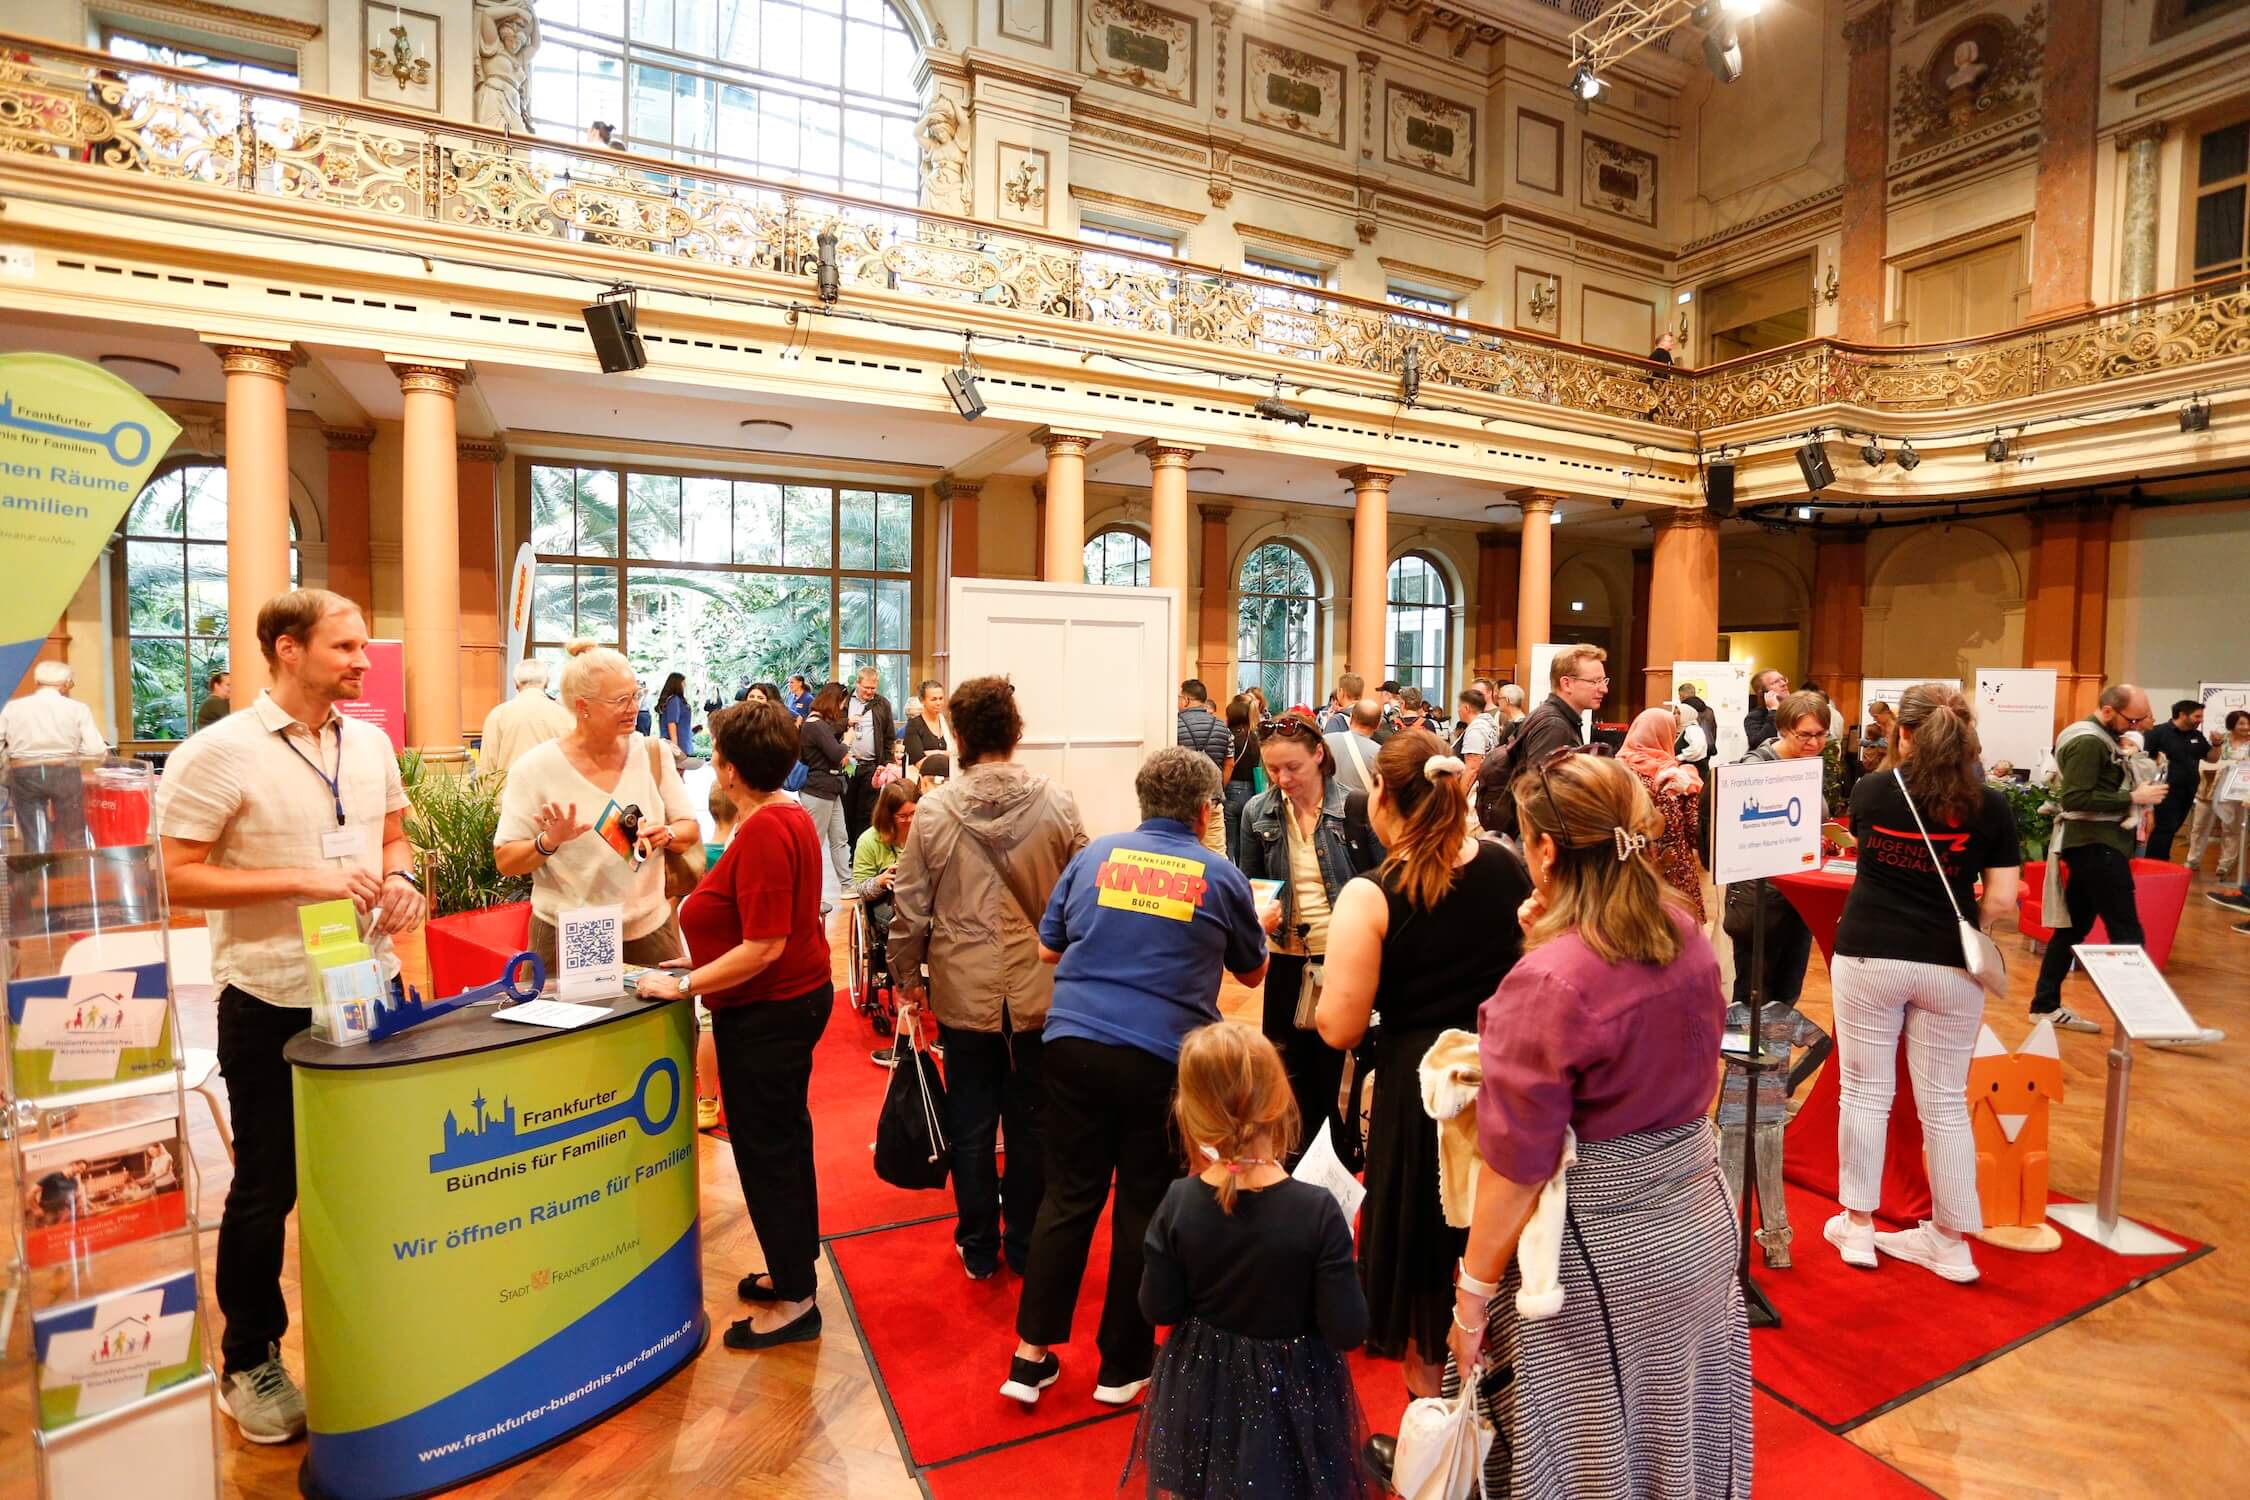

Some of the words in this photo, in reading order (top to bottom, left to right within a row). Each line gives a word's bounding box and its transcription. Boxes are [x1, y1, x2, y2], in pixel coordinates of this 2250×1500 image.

[17, 406, 93, 429] Frankfurter
[21, 433, 41, 445] für
[44, 437, 97, 455] Familien
[50, 465, 129, 493] Räume
[1127, 854, 1187, 869] FRANKFURTER
[1094, 861, 1210, 907] KINDER
[523, 1089, 618, 1127] Frankfurter
[447, 1161, 527, 1193] Bündnis
[531, 1152, 558, 1171] für
[562, 1129, 627, 1161] Familien
[393, 1237, 439, 1261] Wir
[446, 1215, 523, 1250] öffnen
[530, 1190, 601, 1225] Räume
[606, 1174, 631, 1197] für
[635, 1143, 693, 1183] Familien
[499, 1284, 530, 1304] STADT
[552, 1256, 600, 1285] FRANKFURT
[418, 1319, 693, 1463] www.frankfurter-buendnis-fuer-familien.de
